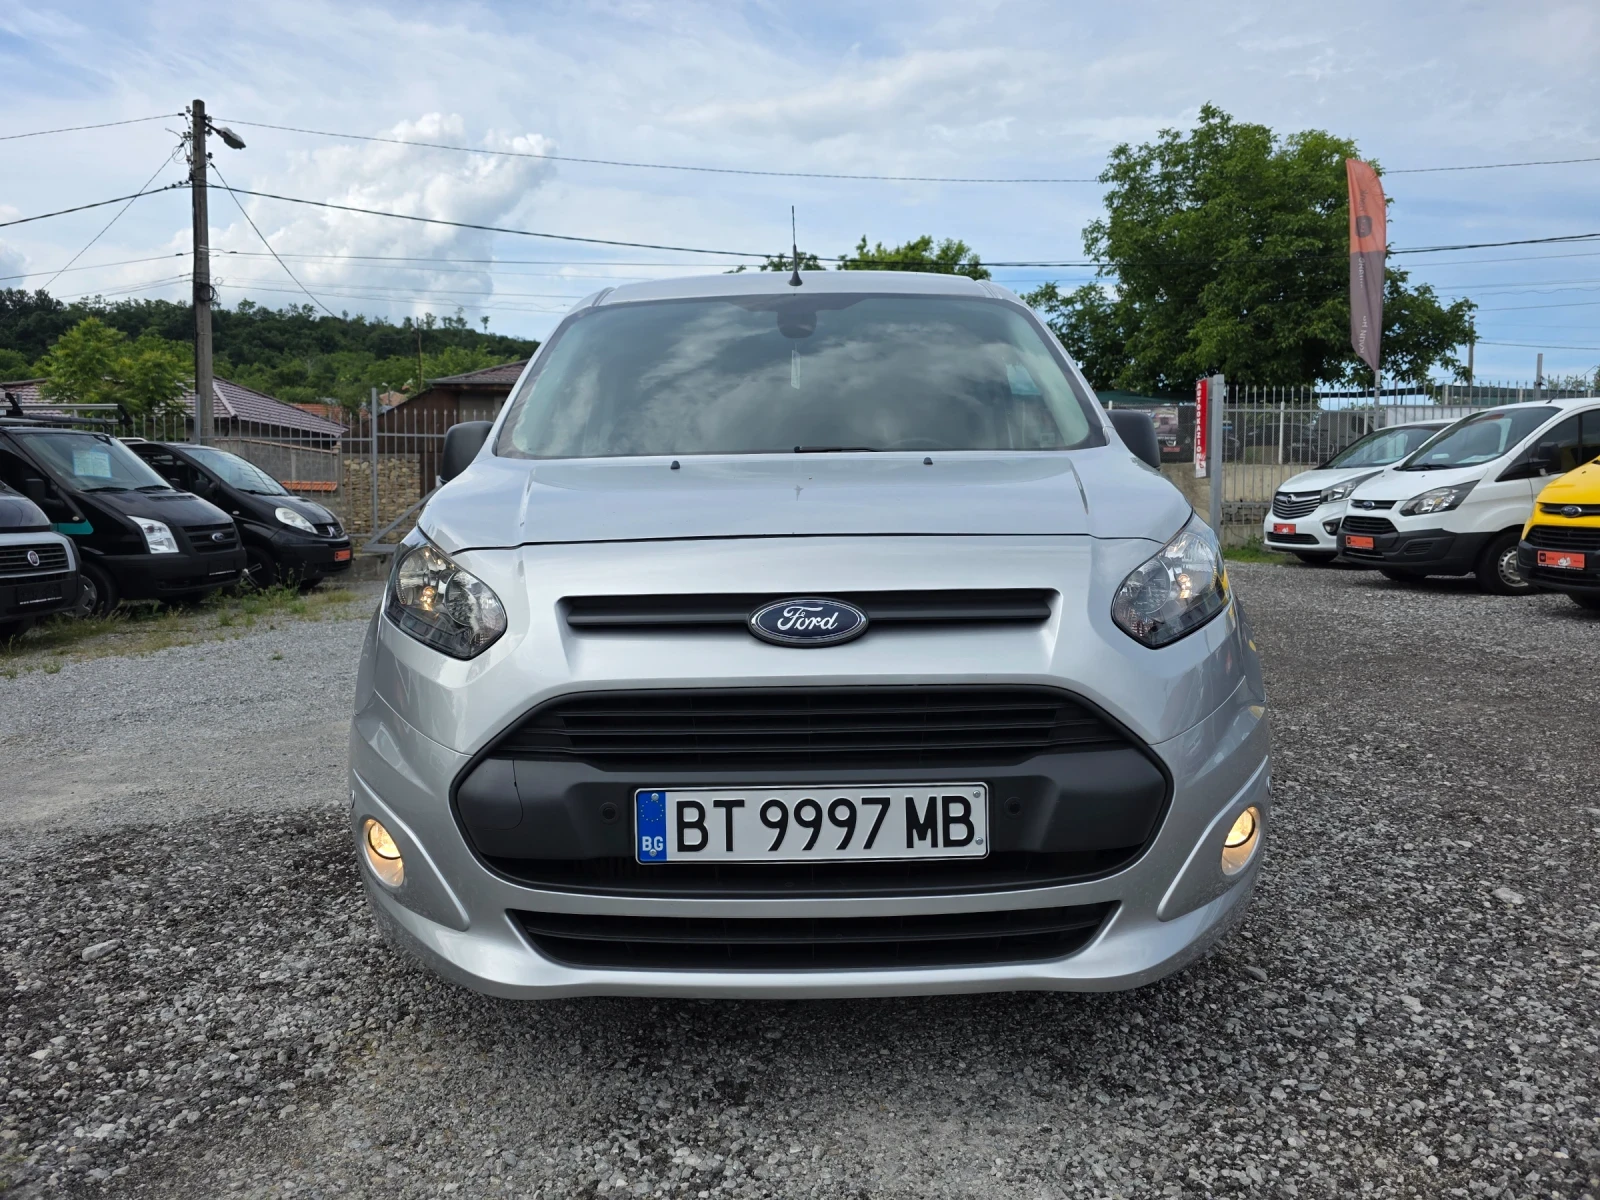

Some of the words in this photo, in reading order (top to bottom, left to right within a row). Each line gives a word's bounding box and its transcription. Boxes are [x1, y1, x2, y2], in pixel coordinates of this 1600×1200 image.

[777, 606, 839, 631] Ford
[676, 799, 746, 853] BT
[759, 796, 891, 852] 9997
[905, 795, 976, 849] MB
[642, 836, 664, 852] BG
